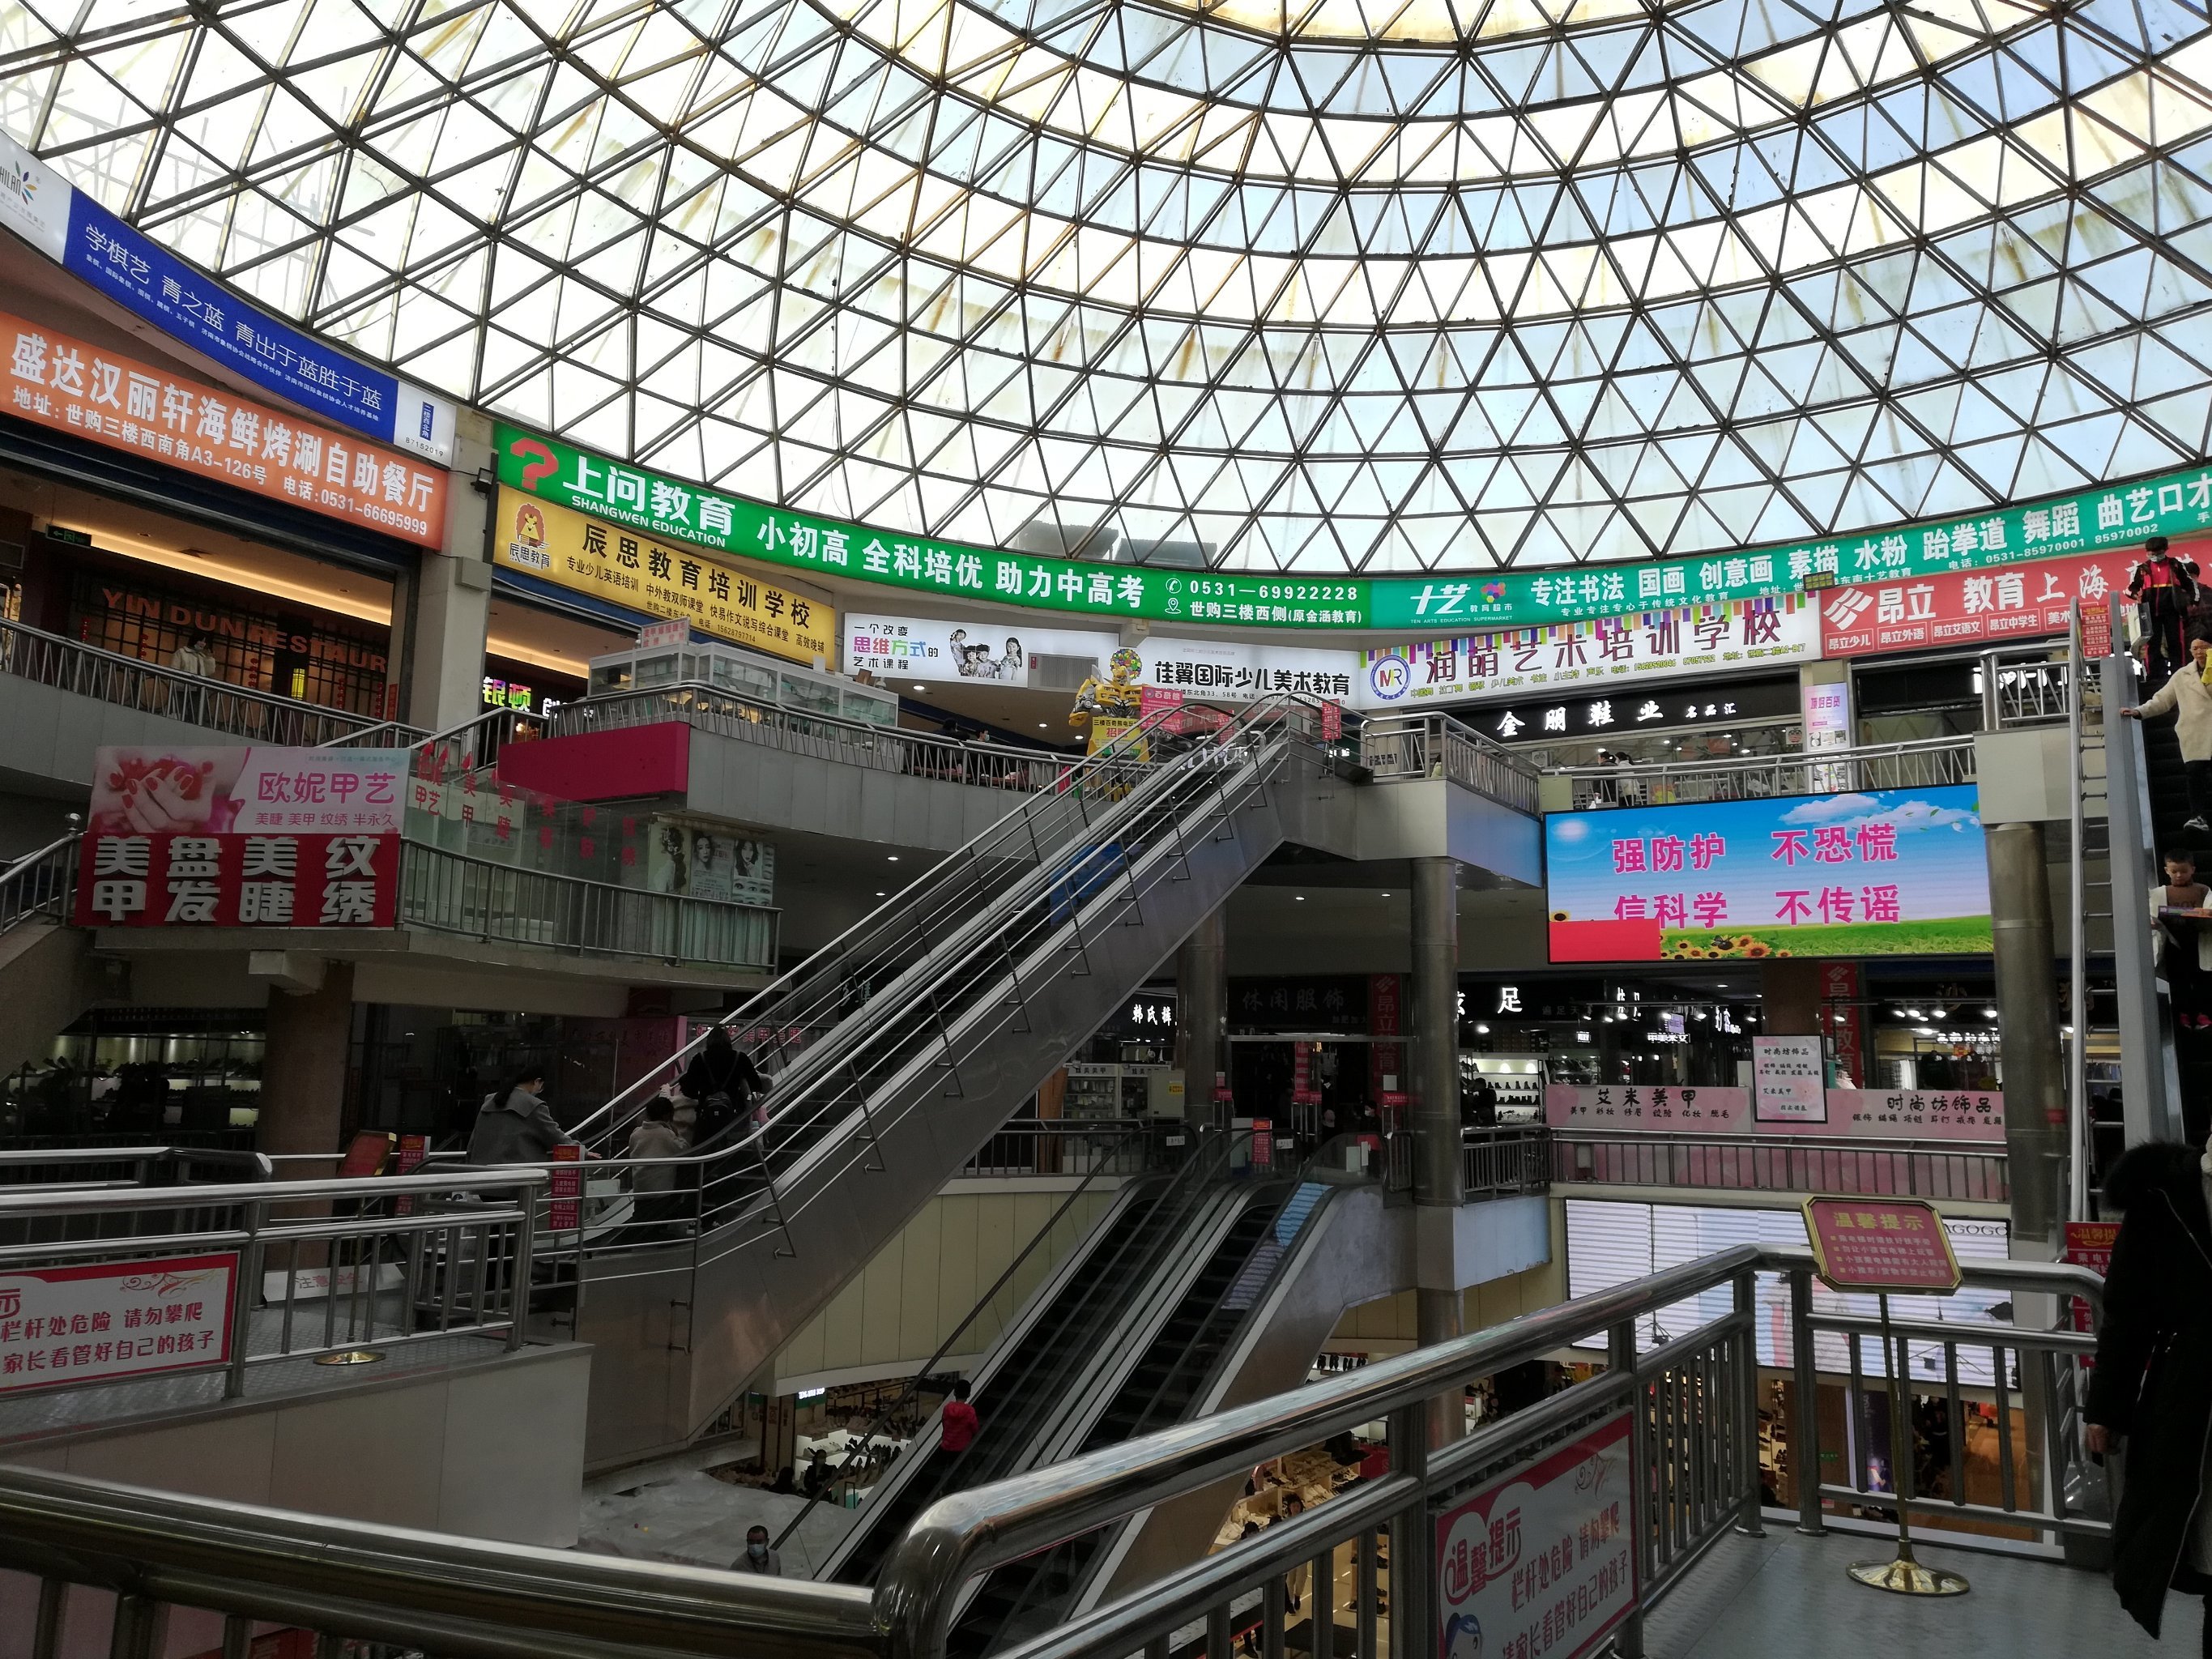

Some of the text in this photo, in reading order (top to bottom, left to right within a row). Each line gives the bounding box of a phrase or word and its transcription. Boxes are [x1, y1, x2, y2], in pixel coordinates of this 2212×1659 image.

[86, 224, 382, 410] 学棋艺 青之蓝 青出于蓝胜于蓝
[11, 332, 433, 513] 盛达汉丽轩海鲜烤涮自助餐厅
[406, 437, 443, 457] 87152019
[563, 455, 1144, 608] 上问教育 小初高 全科培优 助力中高考
[572, 495, 726, 547] SHANGWEN EDUCATION
[1532, 573, 1625, 606] 专注书法
[1639, 565, 1685, 598] 国画
[1699, 554, 1773, 591] 创意画
[1788, 544, 1839, 580] 素描
[1854, 534, 1907, 570] 水粉
[1923, 516, 2007, 561] 跆拳道
[2022, 501, 2080, 544] 舞蹈
[2098, 473, 2212, 531] 曲艺口才
[509, 543, 550, 569] 辰思教育
[582, 523, 811, 629] 辰思教育培训学校
[1561, 591, 1728, 617] 专业专注专心于传统文化教育
[2095, 523, 2159, 544] 85970002
[103, 588, 160, 619] YIN
[170, 606, 245, 638] DUN
[567, 556, 639, 592] 专业少儿英语培训
[646, 583, 704, 614] 中外教双师课堂
[710, 604, 789, 642] 快易作文说写综合课堂
[1470, 603, 1512, 613] 教育超市
[1877, 583, 1937, 625] 昂立
[1963, 573, 2025, 614] 教育
[854, 636, 939, 658] 思维方式的
[855, 624, 909, 637] 一个改变
[1426, 610, 1781, 684] 润萌艺术培训学校
[1828, 633, 1871, 651] 昂立少儿
[1880, 627, 1924, 645] 昂立外语
[1933, 620, 1981, 638] 昂立艾语文
[1989, 614, 2039, 632] 昂立中学生
[853, 656, 909, 670] 艺术课程
[1491, 676, 1524, 689] 少儿美术
[1686, 702, 1737, 719] 名品汇
[1810, 696, 1840, 709] 顶好百货
[258, 771, 396, 805] 欧妮甲艺
[254, 812, 394, 826] 美睫 美甲 纹绣 半永久
[1612, 822, 1899, 875] 强防护 不恐慌
[92, 836, 151, 921] 美甲
[164, 836, 223, 922] 盘发
[238, 836, 298, 922] 美睫
[320, 837, 380, 923] 纹绣
[1614, 884, 1902, 929] 信科学 不传谣
[1242, 987, 1345, 1013] 休闲服饰
[1764, 1047, 1809, 1056] 时尚坊饰品
[1570, 1107, 1587, 1115] 美甲
[1596, 1088, 1696, 1108] 艾米美甲
[1887, 1094, 1992, 1114] 时尚坊饰品
[1835, 1212, 1924, 1230] 温馨提示
[1, 1302, 202, 1343] 栏杆处危险 请勿攀爬
[2, 1329, 215, 1375] 家长看管好自己的孩子
[1445, 1506, 1522, 1606] 温馨提示
[1511, 1501, 1620, 1614] 栏杆处危险 请勿攀爬
